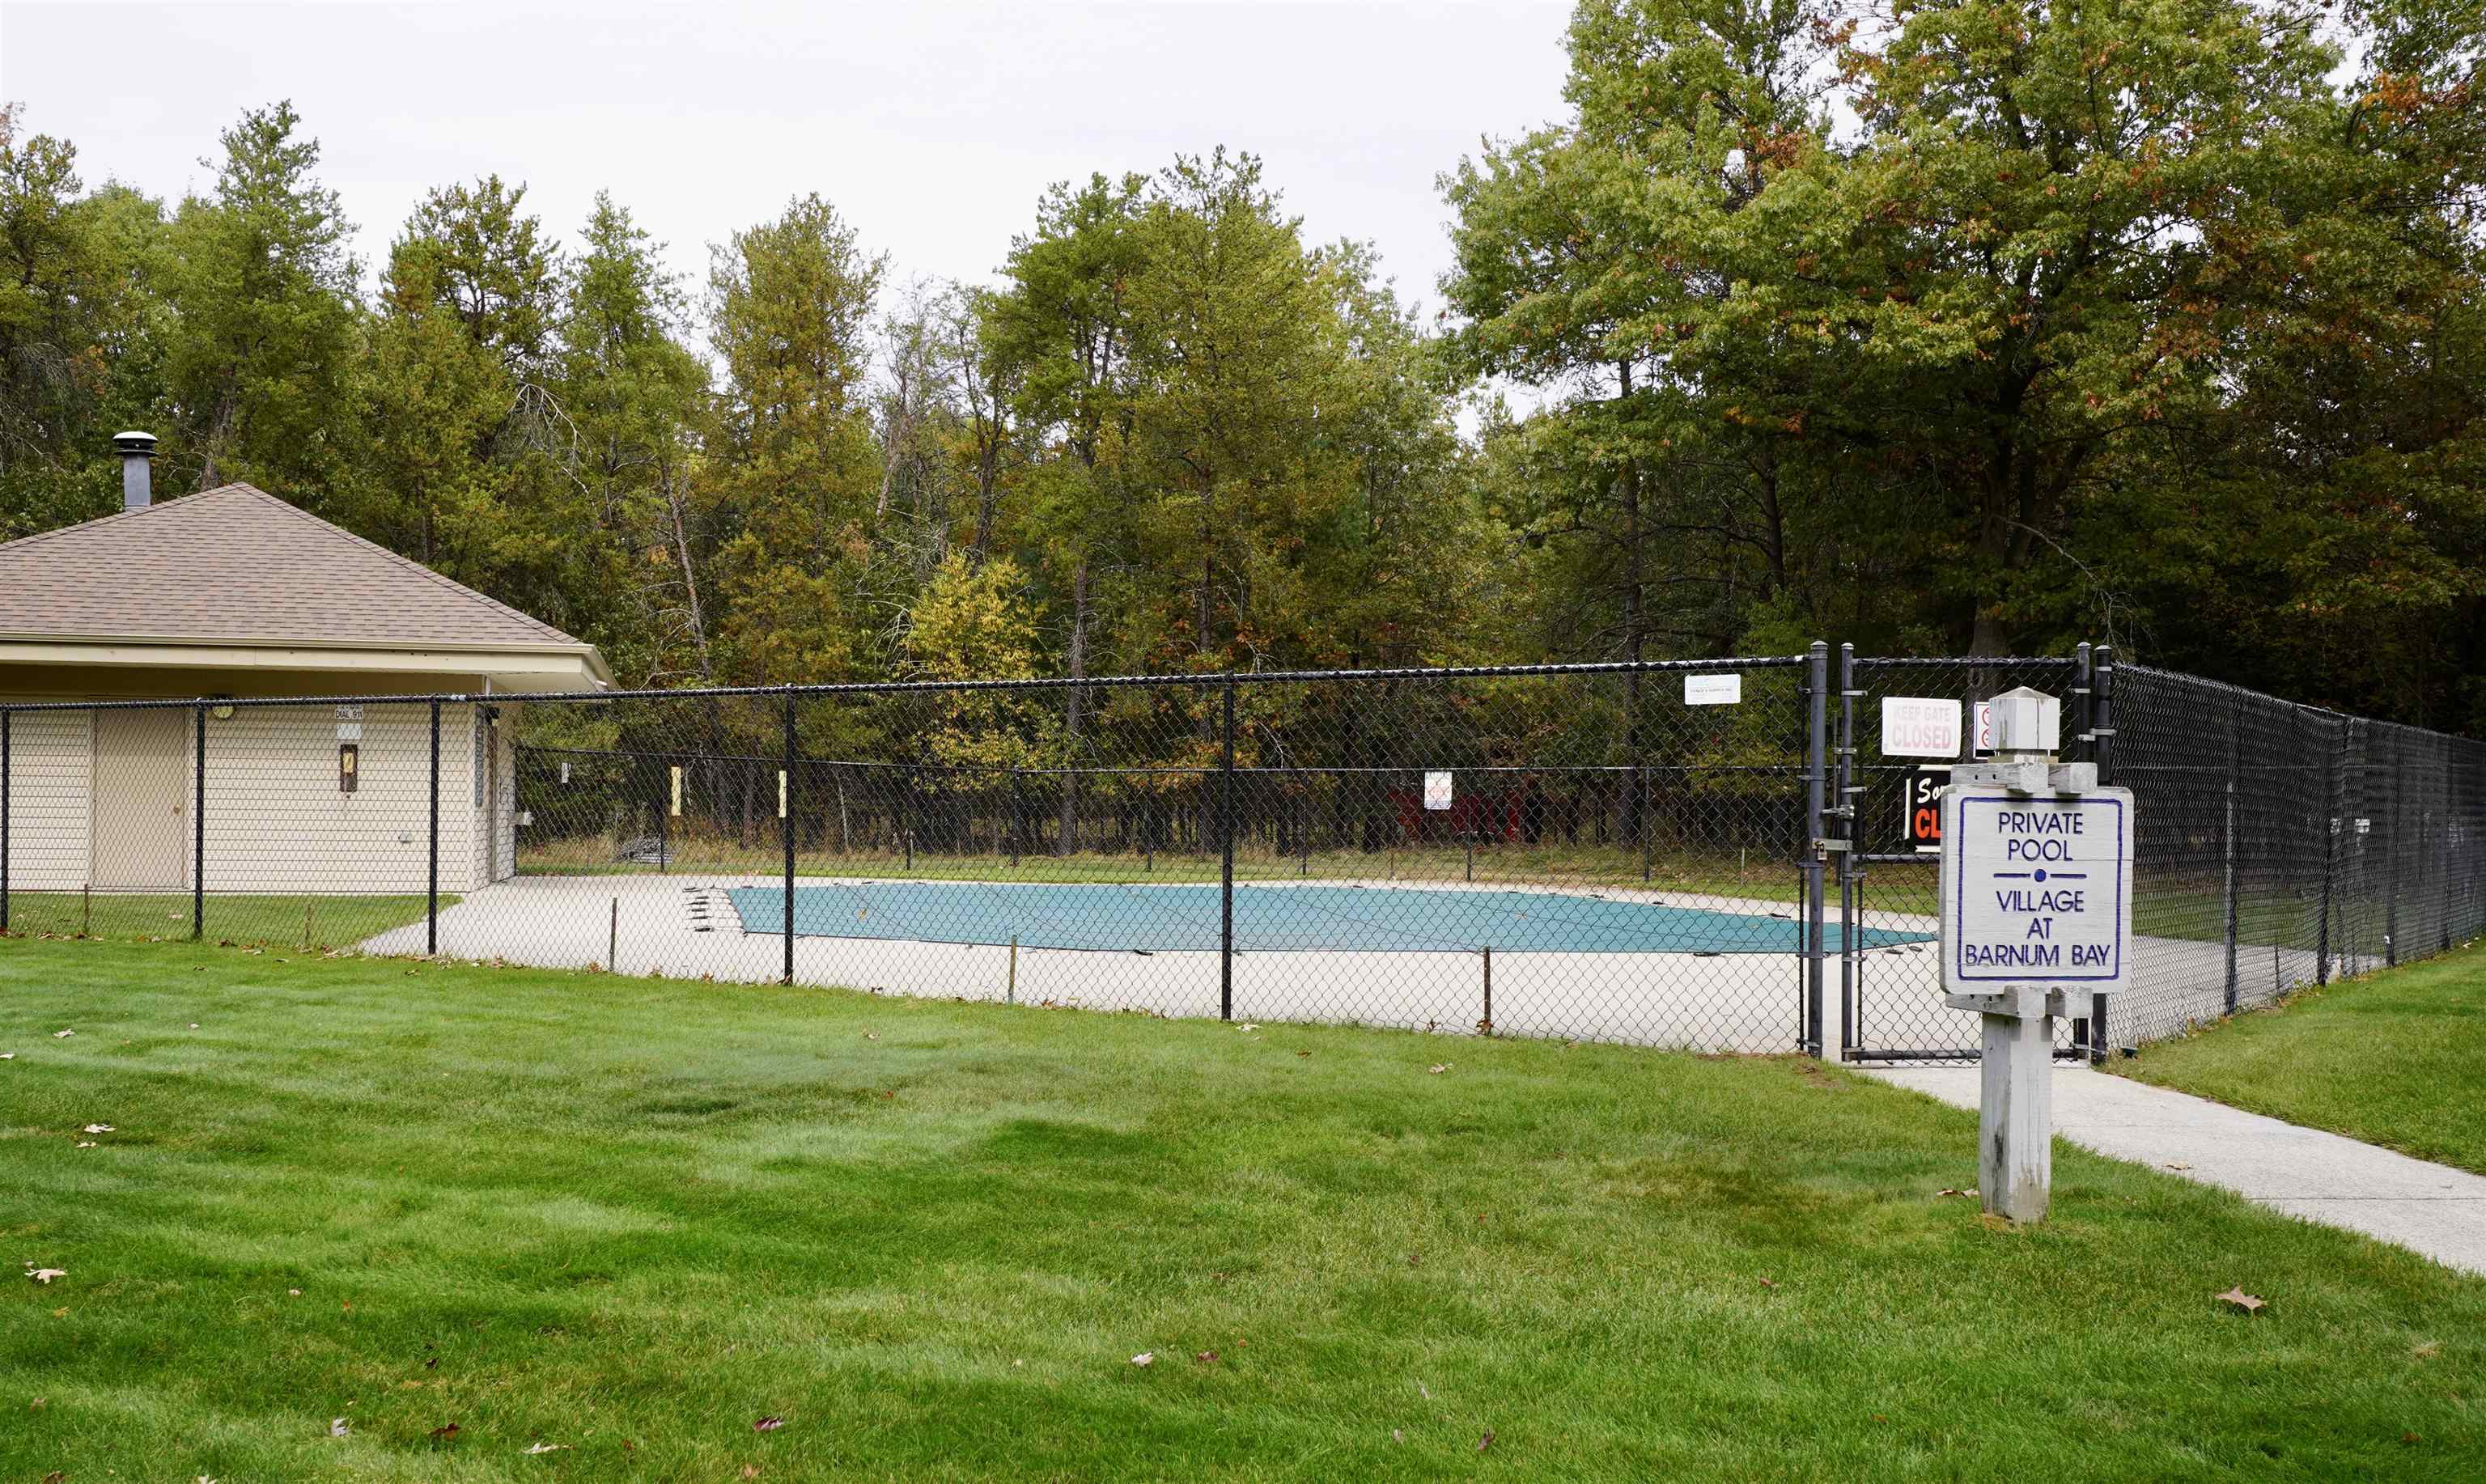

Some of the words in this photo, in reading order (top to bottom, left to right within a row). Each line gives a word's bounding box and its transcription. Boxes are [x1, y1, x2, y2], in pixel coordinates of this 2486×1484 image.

[1924, 706, 1951, 722] GATE
[1892, 725, 1951, 749] CLOSED
[1998, 812, 2083, 834] PRIVATE
[2008, 838, 2073, 861] POOL
[1996, 890, 2085, 913] VILLAGE
[2026, 918, 2053, 939] AT
[1965, 944, 2060, 967] BARNUM
[2071, 944, 2111, 966] BAY
